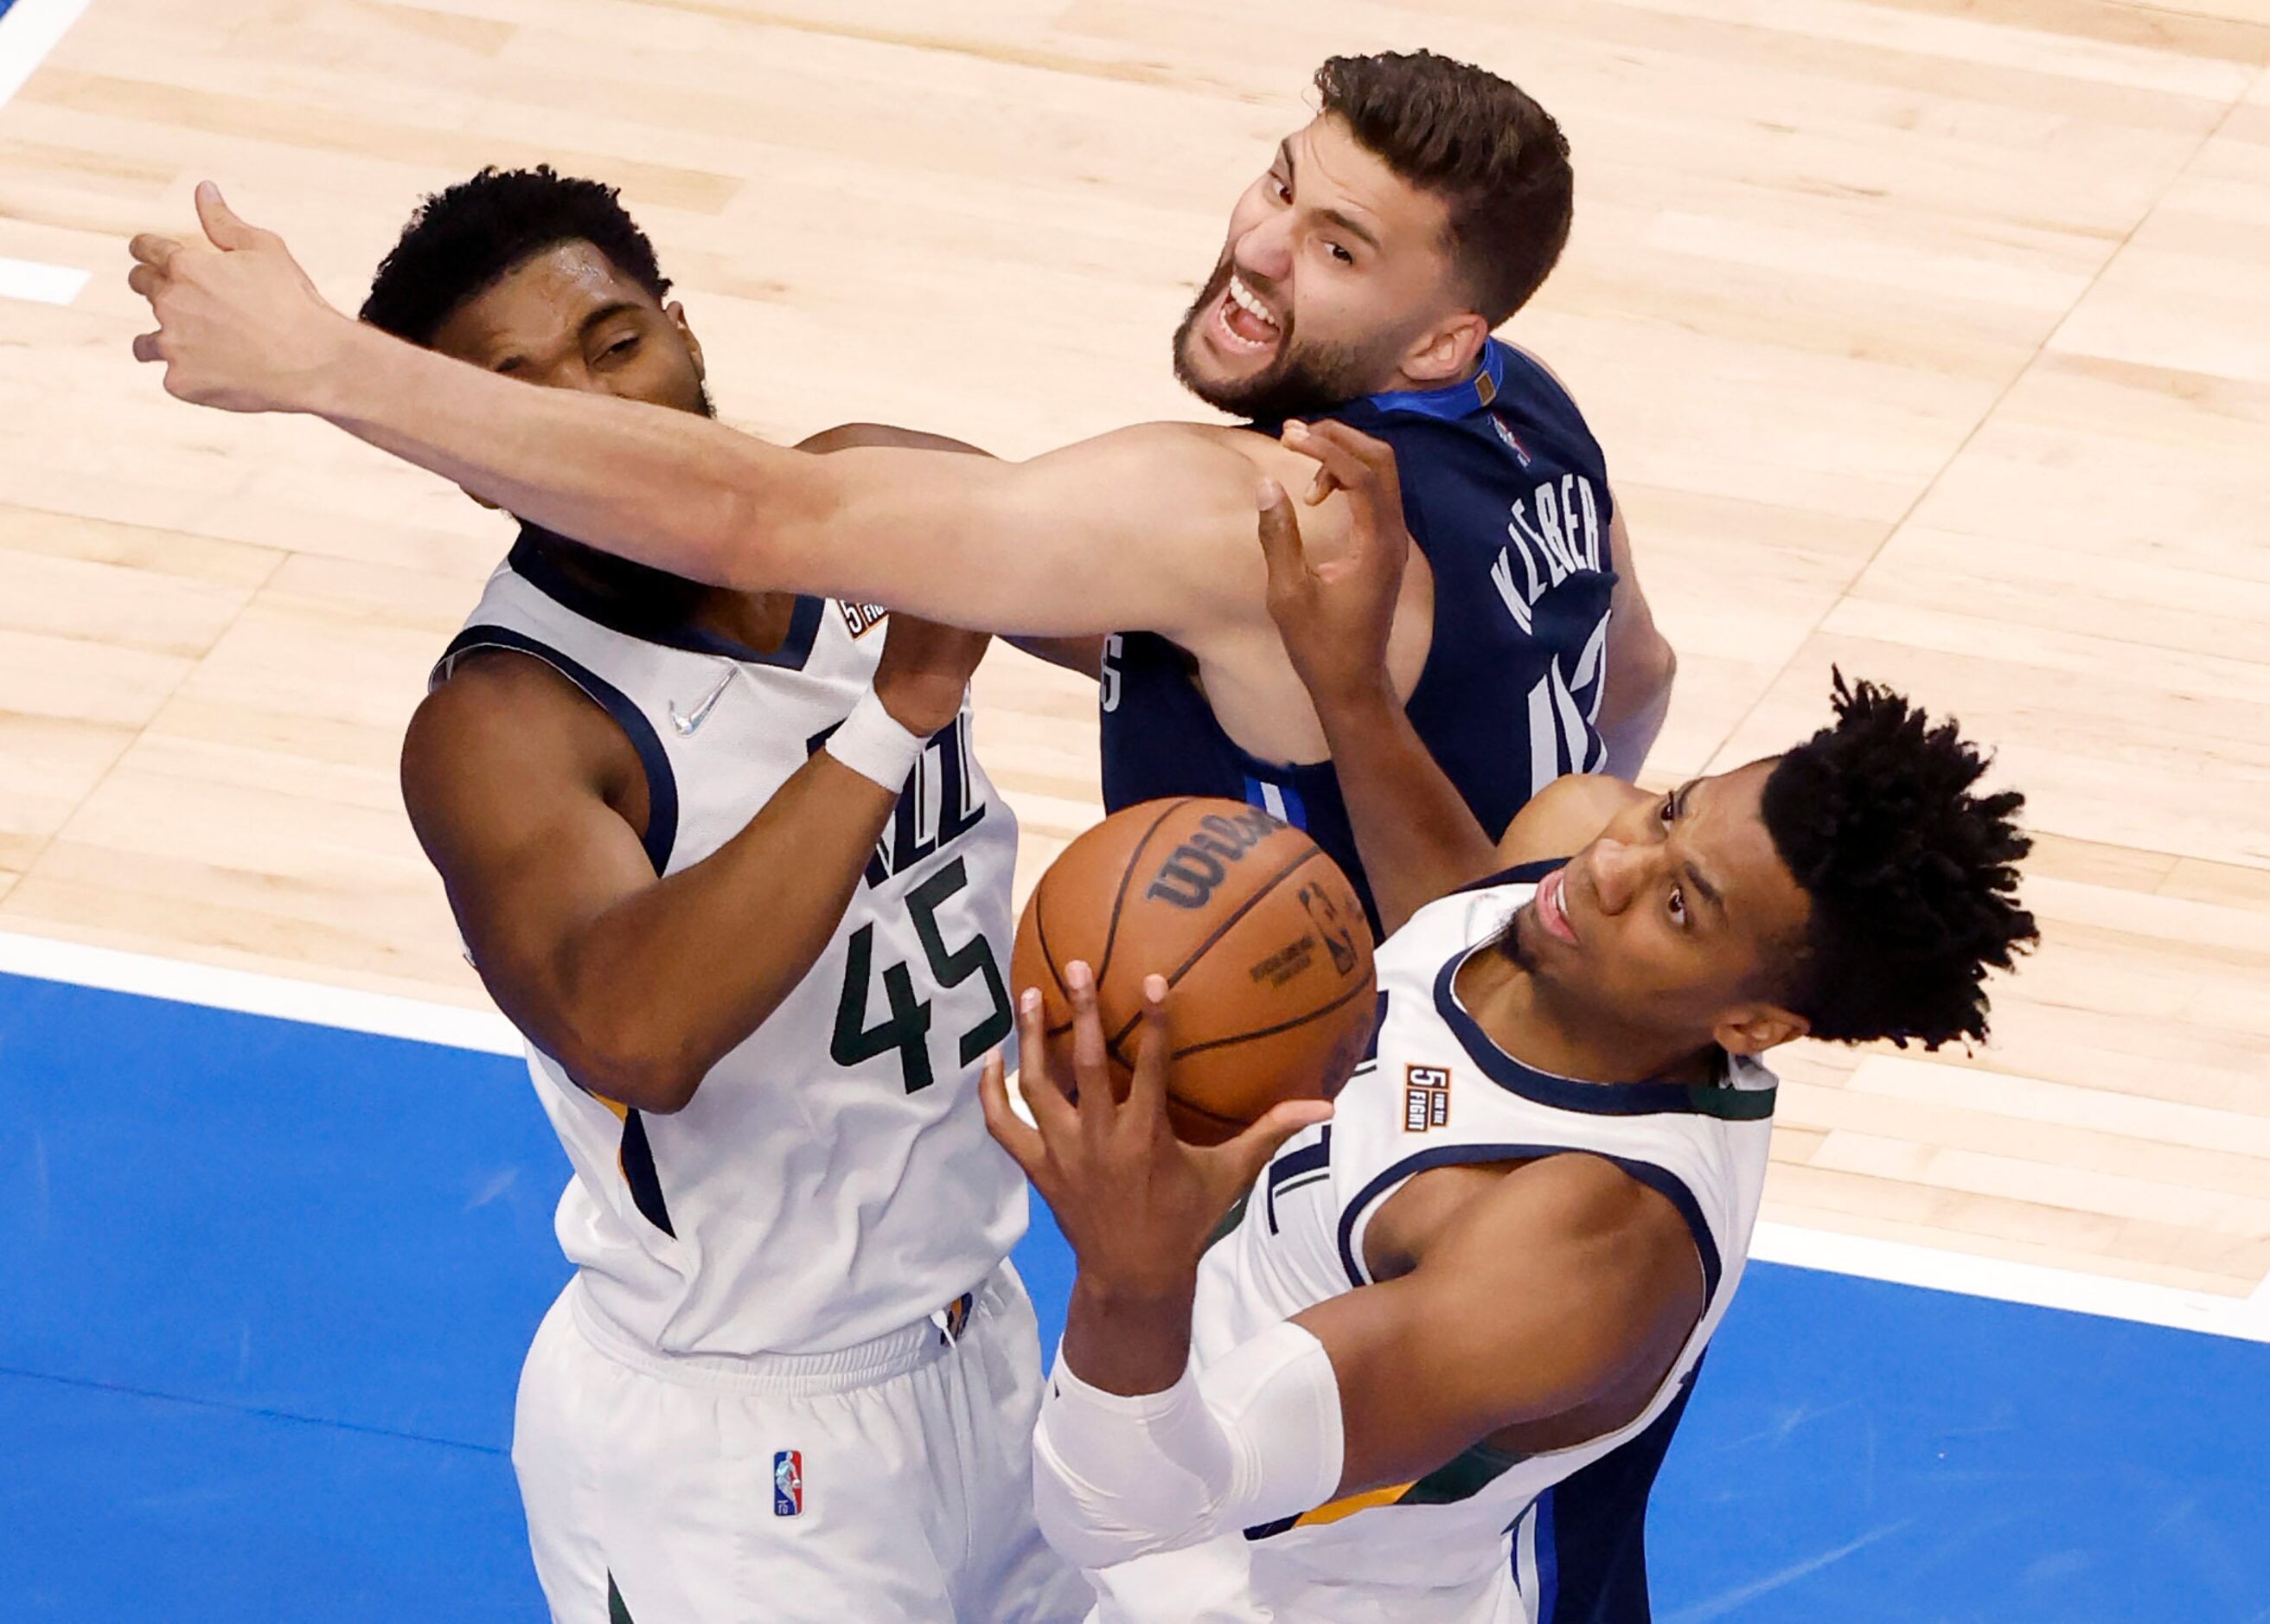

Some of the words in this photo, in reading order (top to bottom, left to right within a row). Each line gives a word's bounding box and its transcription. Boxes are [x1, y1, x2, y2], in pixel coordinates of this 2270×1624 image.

[1491, 473, 1602, 636] KLEBER
[830, 855, 1014, 1095] 45
[1408, 1090, 1427, 1131] FIGHT
[1410, 1068, 1447, 1087] 5
